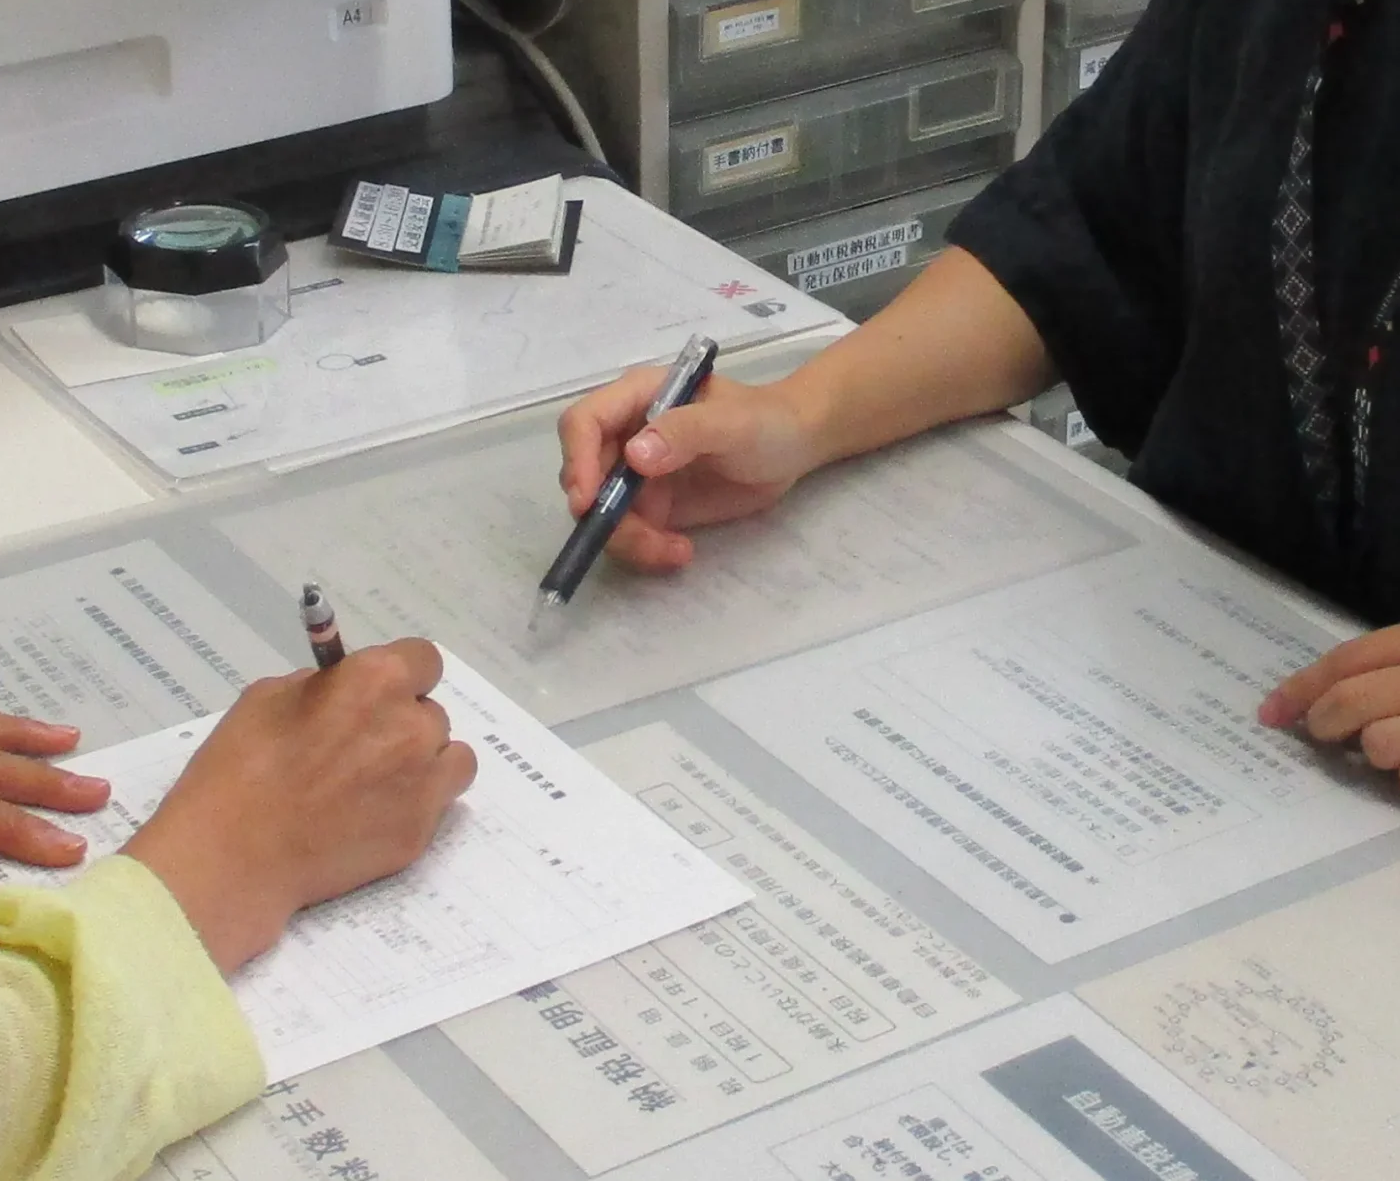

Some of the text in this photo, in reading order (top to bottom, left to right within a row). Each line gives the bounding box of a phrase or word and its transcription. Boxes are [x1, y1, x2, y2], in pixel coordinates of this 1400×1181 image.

[342, 8, 362, 26] A4
[713, 137, 786, 170] 手書納付書
[791, 221, 922, 273] 自動車税納税証明書
